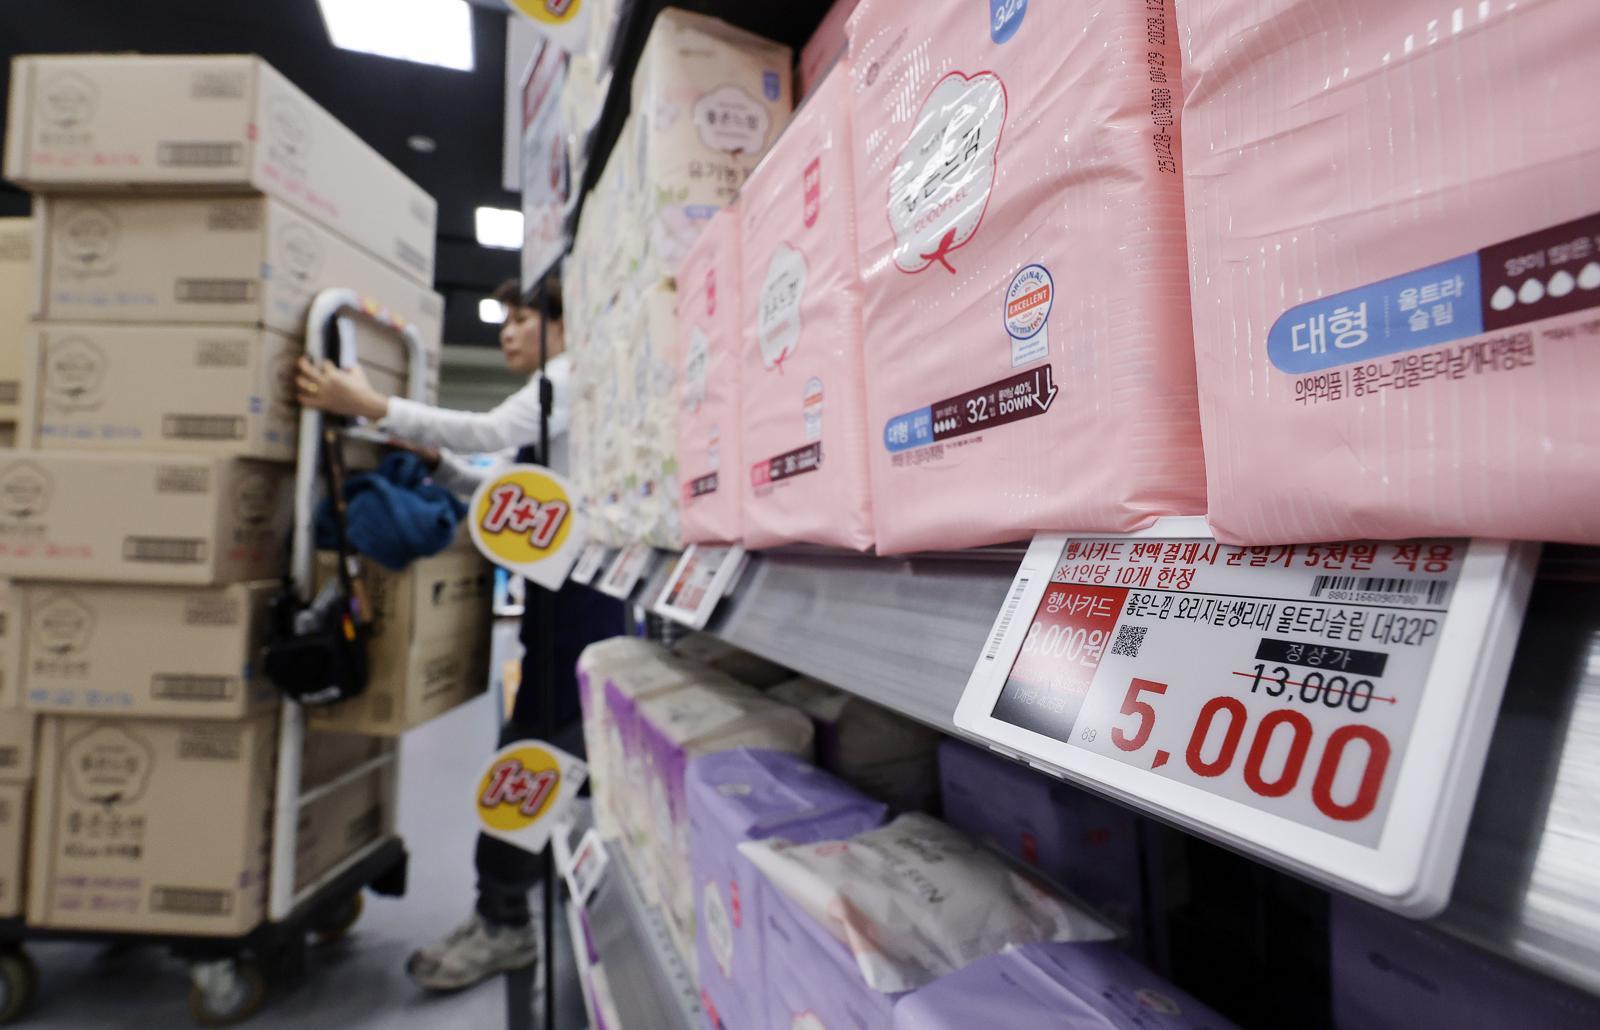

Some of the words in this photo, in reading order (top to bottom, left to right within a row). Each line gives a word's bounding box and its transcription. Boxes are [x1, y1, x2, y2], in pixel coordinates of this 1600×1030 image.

[1148, 52, 1167, 83] 00:29
[1011, 271, 1043, 297] ORIGINAL
[1010, 289, 1047, 314] EXCELLENT
[1291, 302, 1368, 354] 대형
[1397, 275, 1464, 312] 울트라
[1408, 301, 1454, 332] 슬림
[1013, 382, 1032, 396] 40%
[1296, 371, 1342, 405] 의약외품
[966, 396, 989, 424] 32
[1000, 394, 1033, 415] DOWN
[483, 484, 568, 548] 1+1
[1066, 543, 1124, 562] 행사카드
[1226, 545, 1296, 567] 균일가
[1304, 544, 1377, 571] 5천원
[1391, 544, 1454, 573] 적용
[1115, 567, 1153, 588] 10개
[1157, 567, 1197, 590] 한정
[1047, 591, 1114, 618] 행사카드
[1126, 593, 1175, 620] 좋은느낌
[1174, 597, 1277, 631] 오리지널생리대
[1276, 606, 1370, 642] 울트라슬림
[1371, 612, 1438, 646] 대32P
[1021, 621, 1111, 668] 8,000원
[1286, 644, 1352, 670] 정상가
[1251, 664, 1375, 713] 13,000
[1081, 727, 1097, 743] 89
[1112, 677, 1391, 822] 5,000
[482, 760, 558, 816] 1+1
